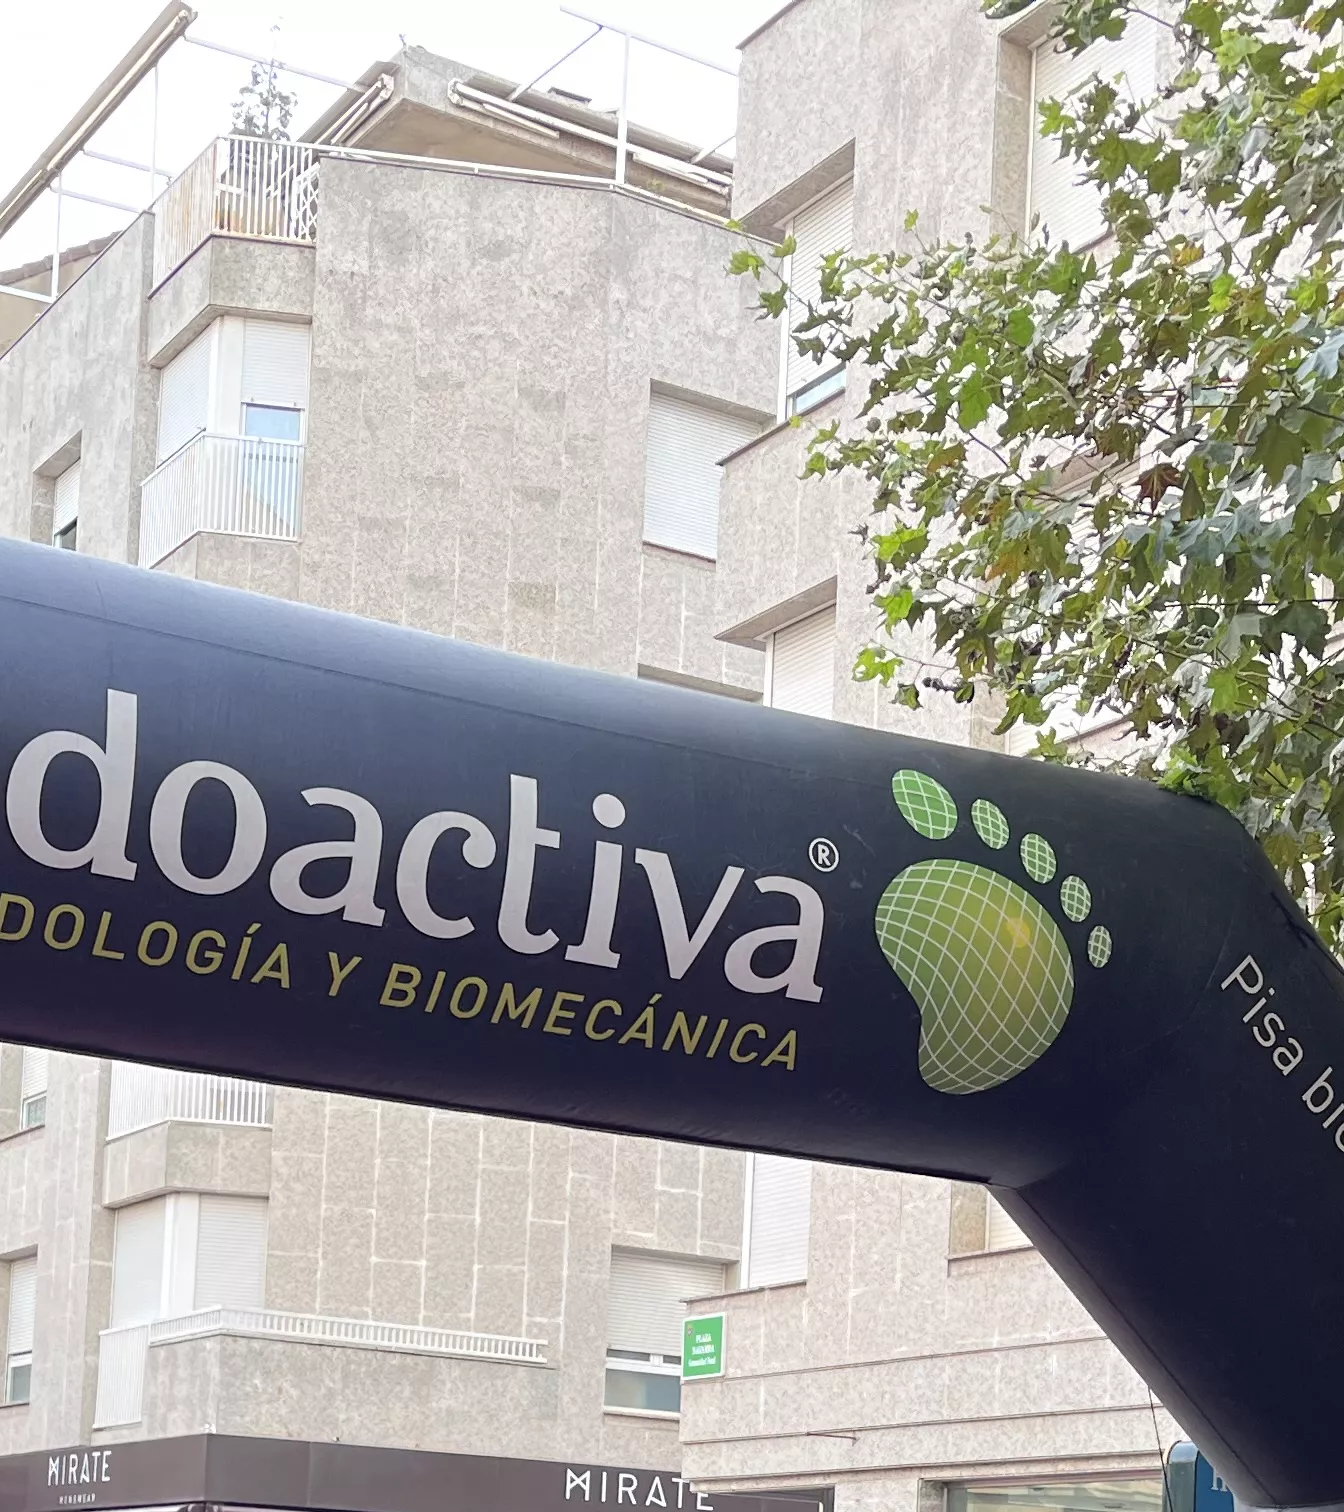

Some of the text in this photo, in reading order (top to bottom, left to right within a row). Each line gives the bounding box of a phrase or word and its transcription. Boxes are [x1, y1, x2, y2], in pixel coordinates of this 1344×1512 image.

[323, 952, 358, 997] Y
[378, 961, 802, 1073] BIOMECÁNICA
[1220, 954, 1306, 1078] Pisa
[46, 1449, 113, 1487] MIRATE
